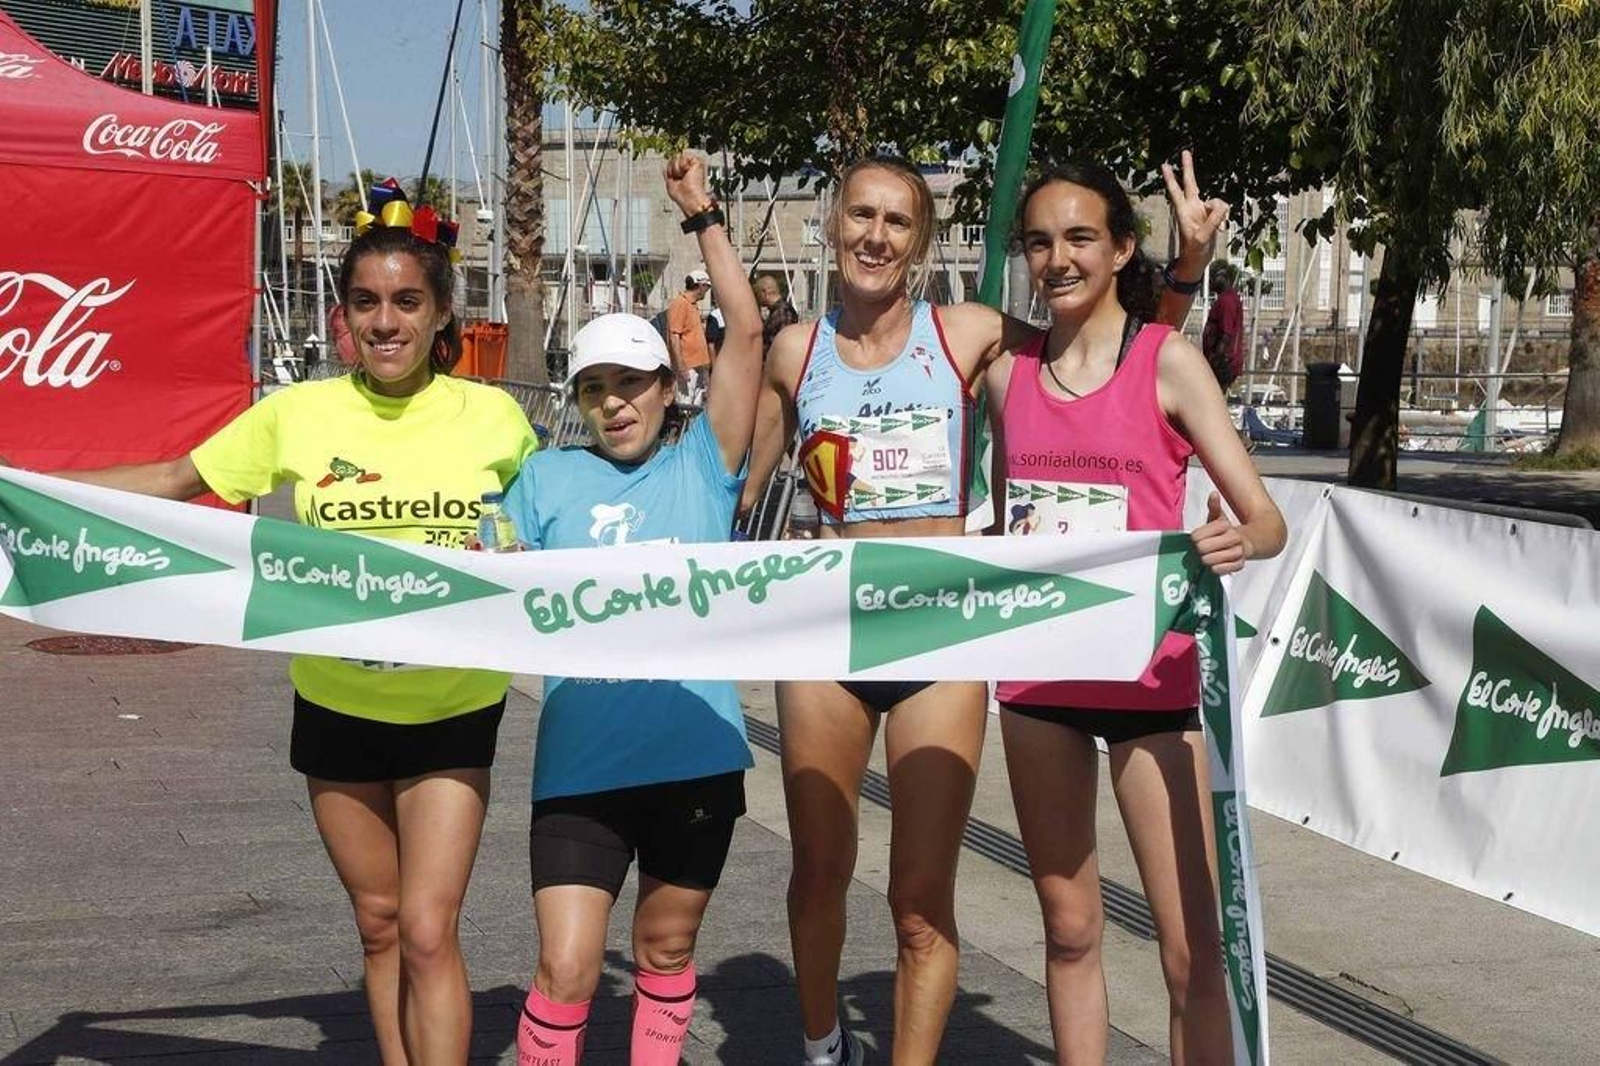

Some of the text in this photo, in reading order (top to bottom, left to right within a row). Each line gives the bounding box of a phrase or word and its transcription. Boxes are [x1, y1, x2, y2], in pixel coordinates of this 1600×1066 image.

[82, 113, 227, 164] Coca-Cola
[873, 448, 909, 470] 902
[319, 491, 482, 522] castrelos
[16, 526, 71, 561] Corte
[73, 527, 170, 576] Inglés
[257, 551, 450, 604] El Corte Inglés
[523, 546, 844, 635] El Corte Inglés
[855, 577, 1066, 620] El Corte Inglés
[1289, 625, 1401, 689] El Corte Inglés
[1466, 671, 1493, 709] El
[1491, 679, 1542, 723] Corte
